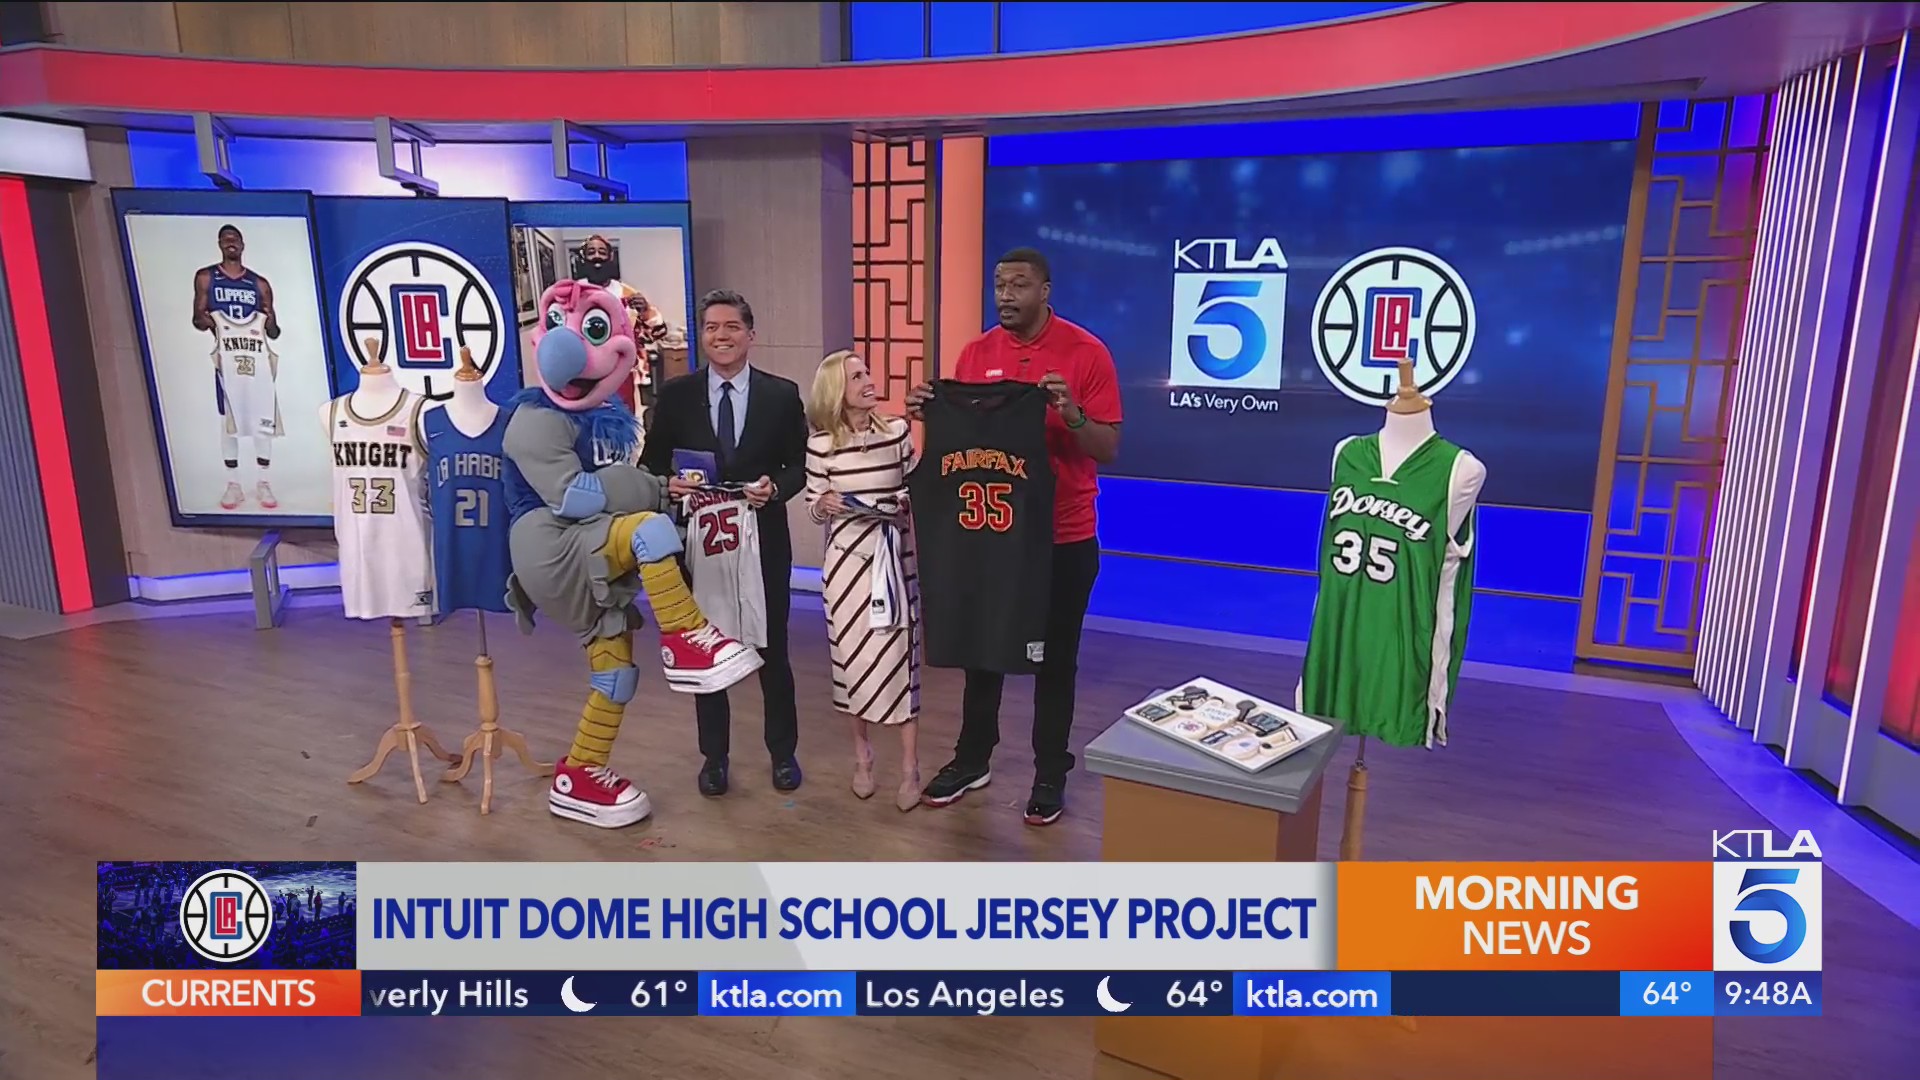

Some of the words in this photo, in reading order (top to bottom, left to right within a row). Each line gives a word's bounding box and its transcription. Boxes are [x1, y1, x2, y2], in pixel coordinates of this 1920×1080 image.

[1174, 238, 1289, 269] KTLA
[214, 287, 256, 304] CLIPPERS
[222, 337, 264, 353] KNIGHT
[1187, 280, 1267, 380] 5
[1170, 391, 1201, 408] LA's
[1204, 393, 1239, 413] Very
[1242, 395, 1279, 411] Own
[333, 442, 412, 468] KNIGHT
[436, 456, 449, 488] LA
[941, 448, 1028, 480] FAIRFAX
[349, 477, 395, 514] 33
[455, 488, 490, 528] 21
[959, 481, 1013, 532] 35
[1330, 486, 1431, 540] Dorsey
[700, 507, 739, 557] 25
[1332, 529, 1399, 583] 35
